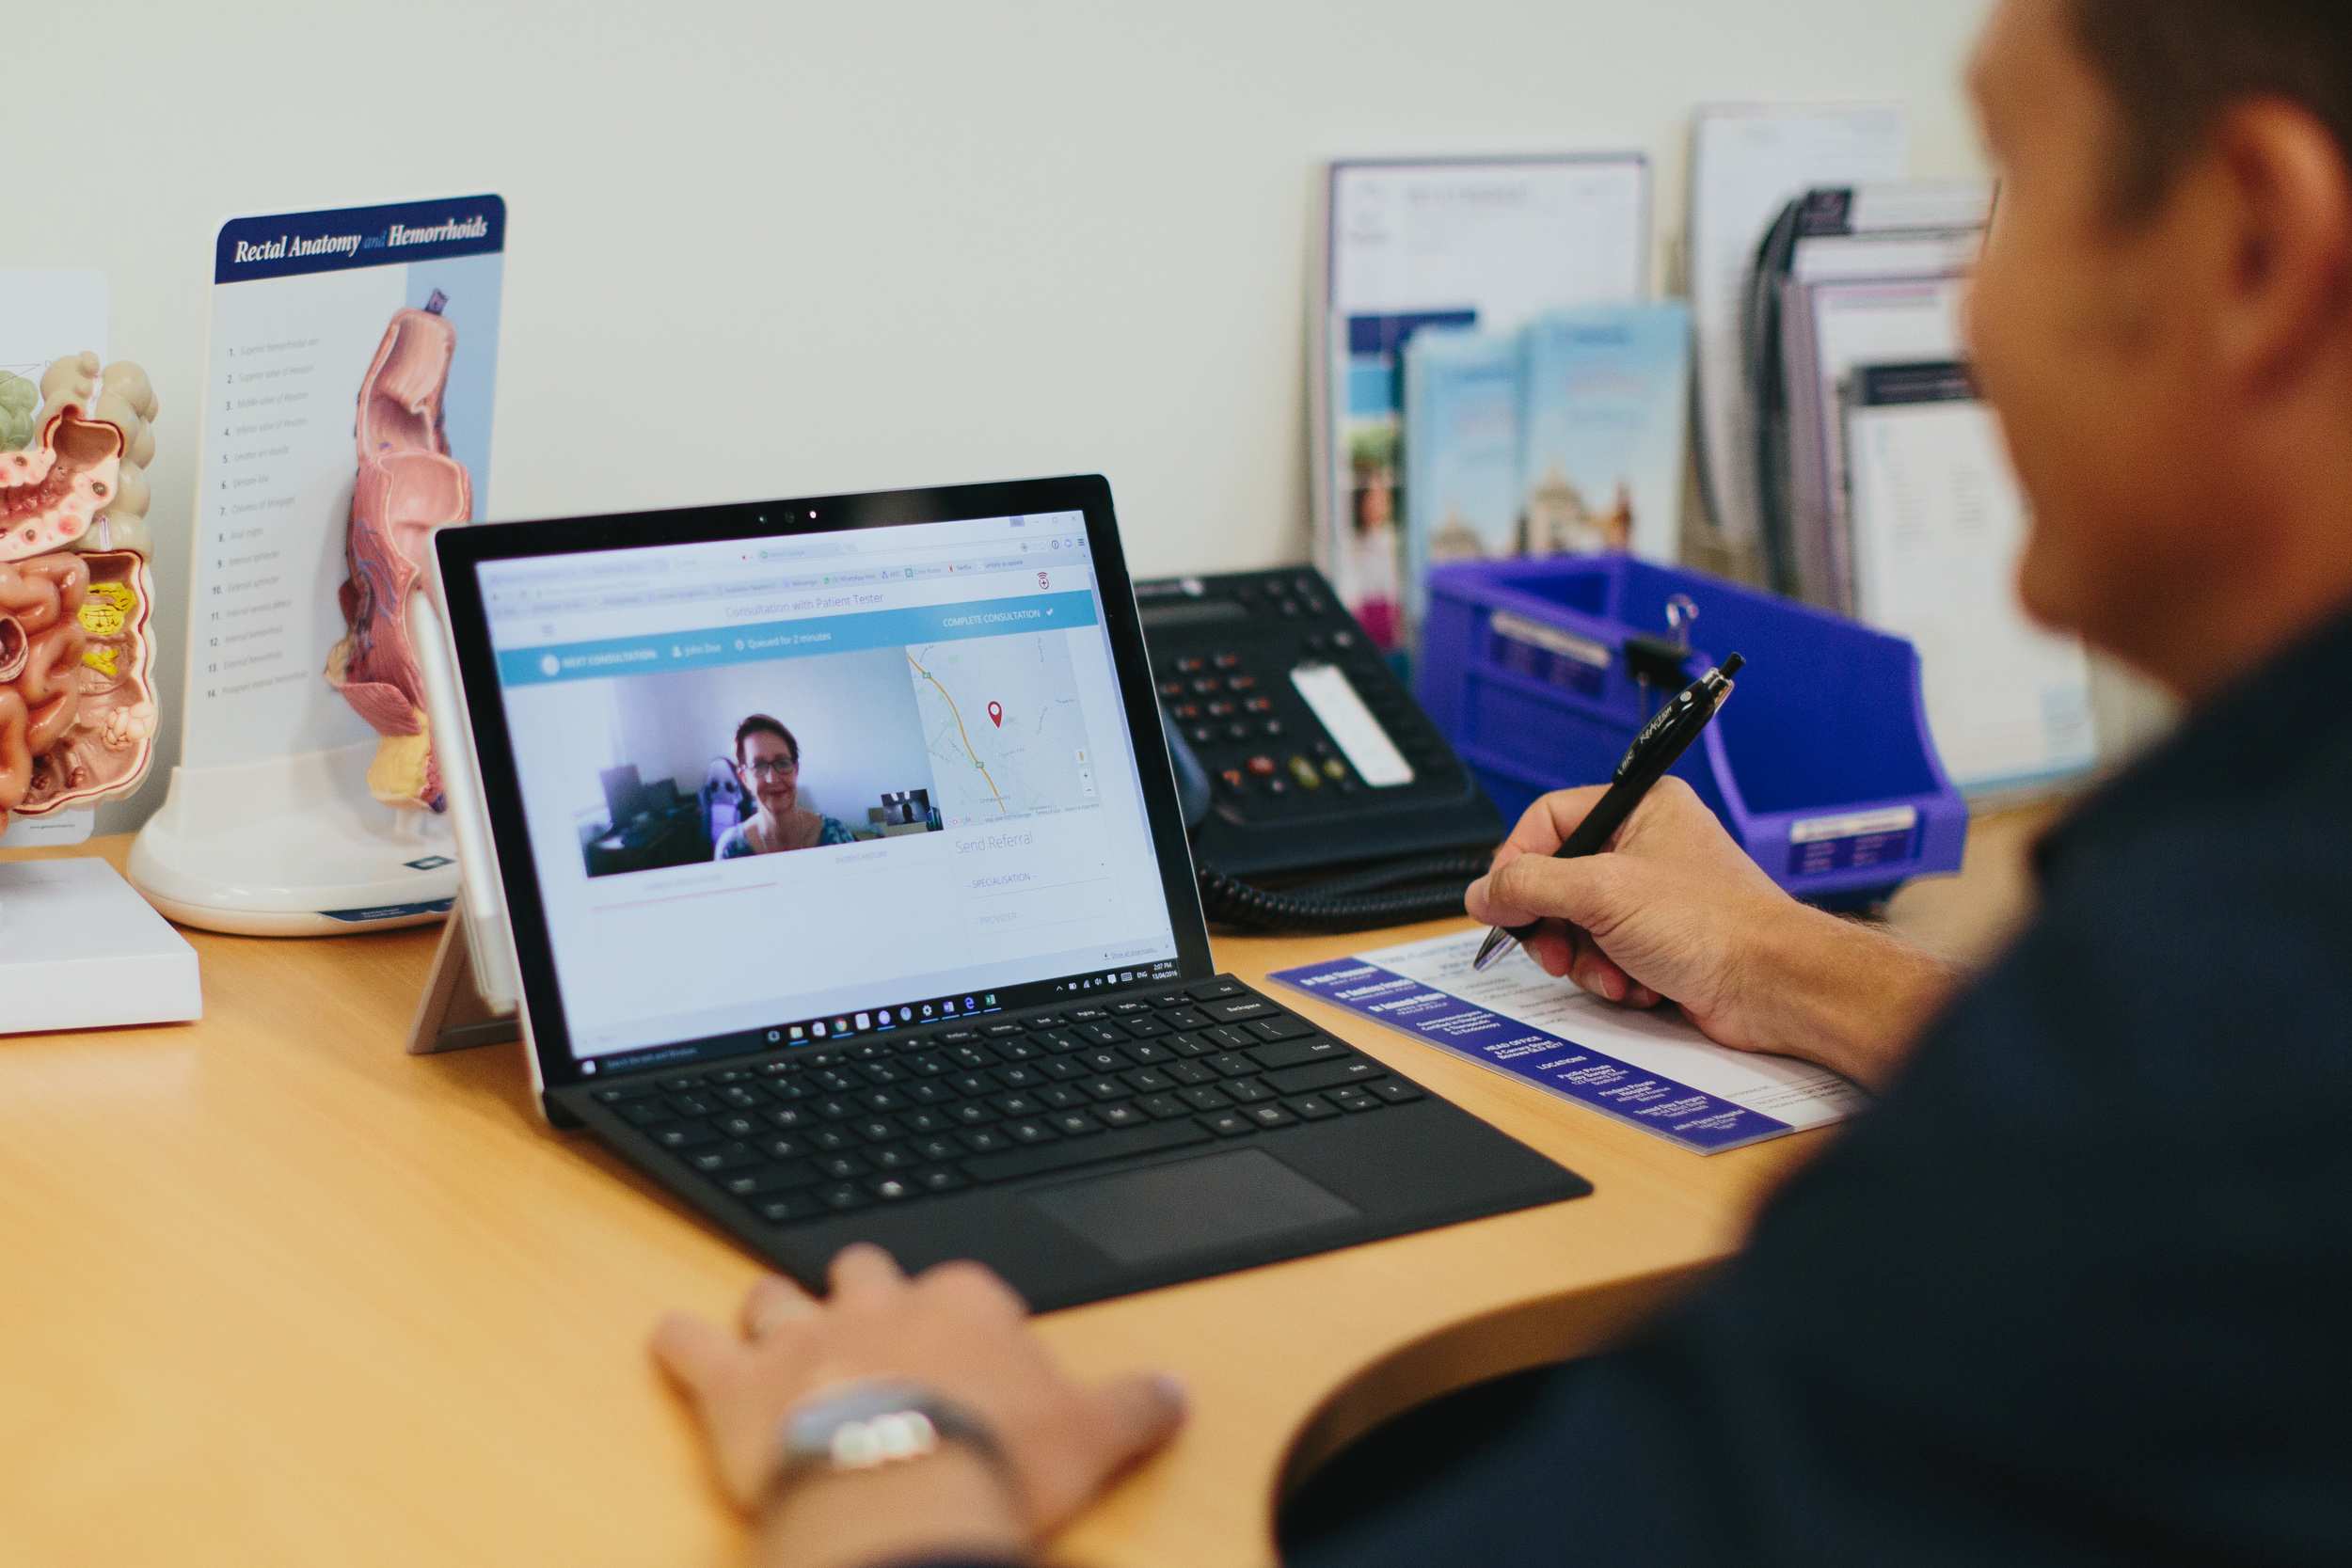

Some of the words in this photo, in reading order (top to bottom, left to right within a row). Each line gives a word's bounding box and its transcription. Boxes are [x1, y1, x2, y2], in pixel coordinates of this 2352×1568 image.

[235, 235, 287, 263] Rectal
[288, 234, 361, 258] Anatomy
[364, 230, 388, 250] and
[388, 215, 488, 247] Hemorrhoids
[724, 602, 790, 618] Consultation
[792, 599, 814, 611] with
[816, 595, 850, 609] Patient
[852, 594, 883, 604] Tester
[943, 615, 982, 627] COMPLETE
[984, 609, 1041, 623] CONSULTATION
[748, 638, 779, 650] Queued
[779, 635, 792, 646] for
[793, 635, 799, 644] 2
[800, 632, 832, 643] minutes
[561, 657, 587, 668] NEXT
[588, 649, 657, 667] CONSULTATION
[955, 839, 986, 854] Send
[988, 832, 1034, 851] Referral
[971, 873, 1031, 888] SPECIALISATION
[1226, 1003, 1261, 1012] Backspace
[1507, 1037, 1541, 1045] OFFICE
[1097, 1054, 1112, 1063] O
[1535, 1055, 1587, 1069] LOCATIONS
